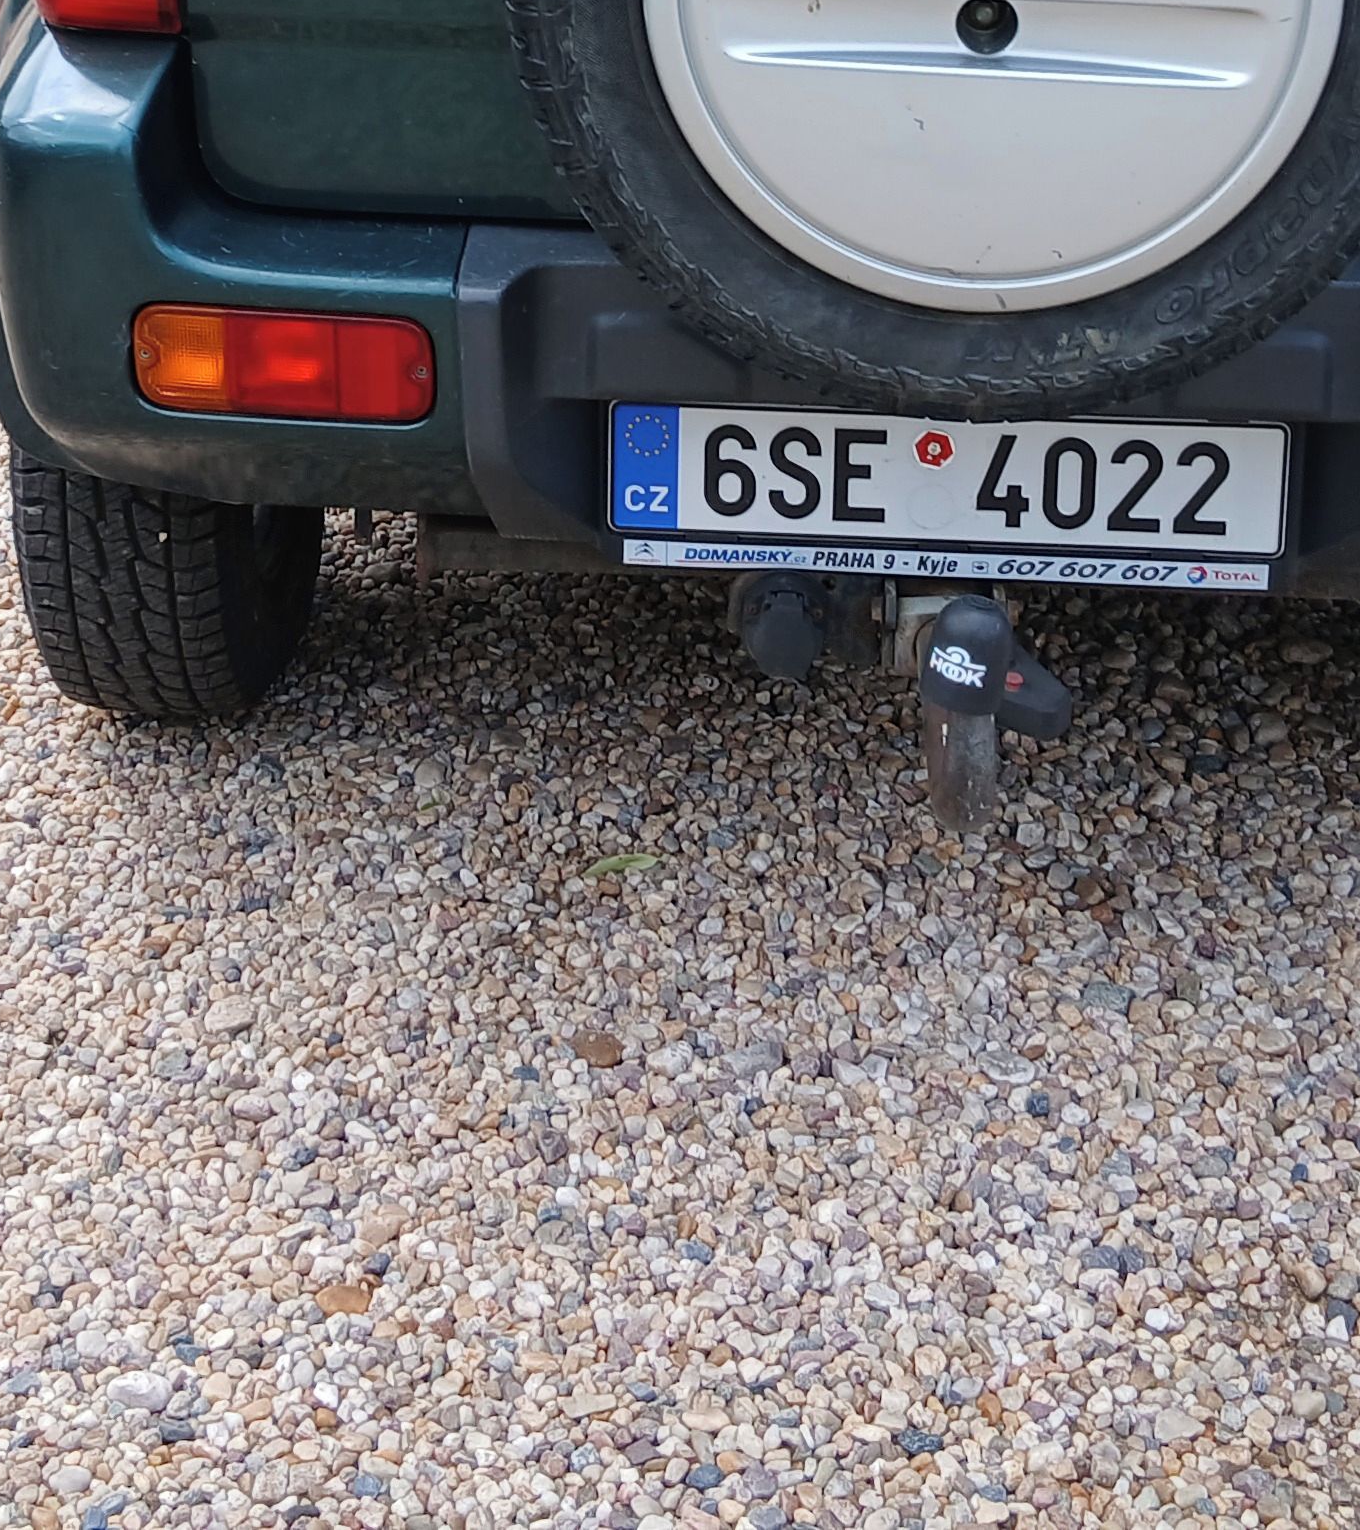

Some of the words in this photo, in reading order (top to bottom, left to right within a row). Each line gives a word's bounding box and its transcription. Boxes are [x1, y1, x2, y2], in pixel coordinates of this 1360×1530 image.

[703, 424, 888, 523] 6SE
[976, 434, 1230, 536] 4022
[624, 484, 669, 514] CZ
[812, 550, 875, 569] PRAHA
[883, 554, 895, 569] 9
[917, 555, 958, 574] Kyje
[997, 559, 1054, 576] 607
[1058, 562, 1116, 579] 607
[1120, 565, 1178, 582] 607
